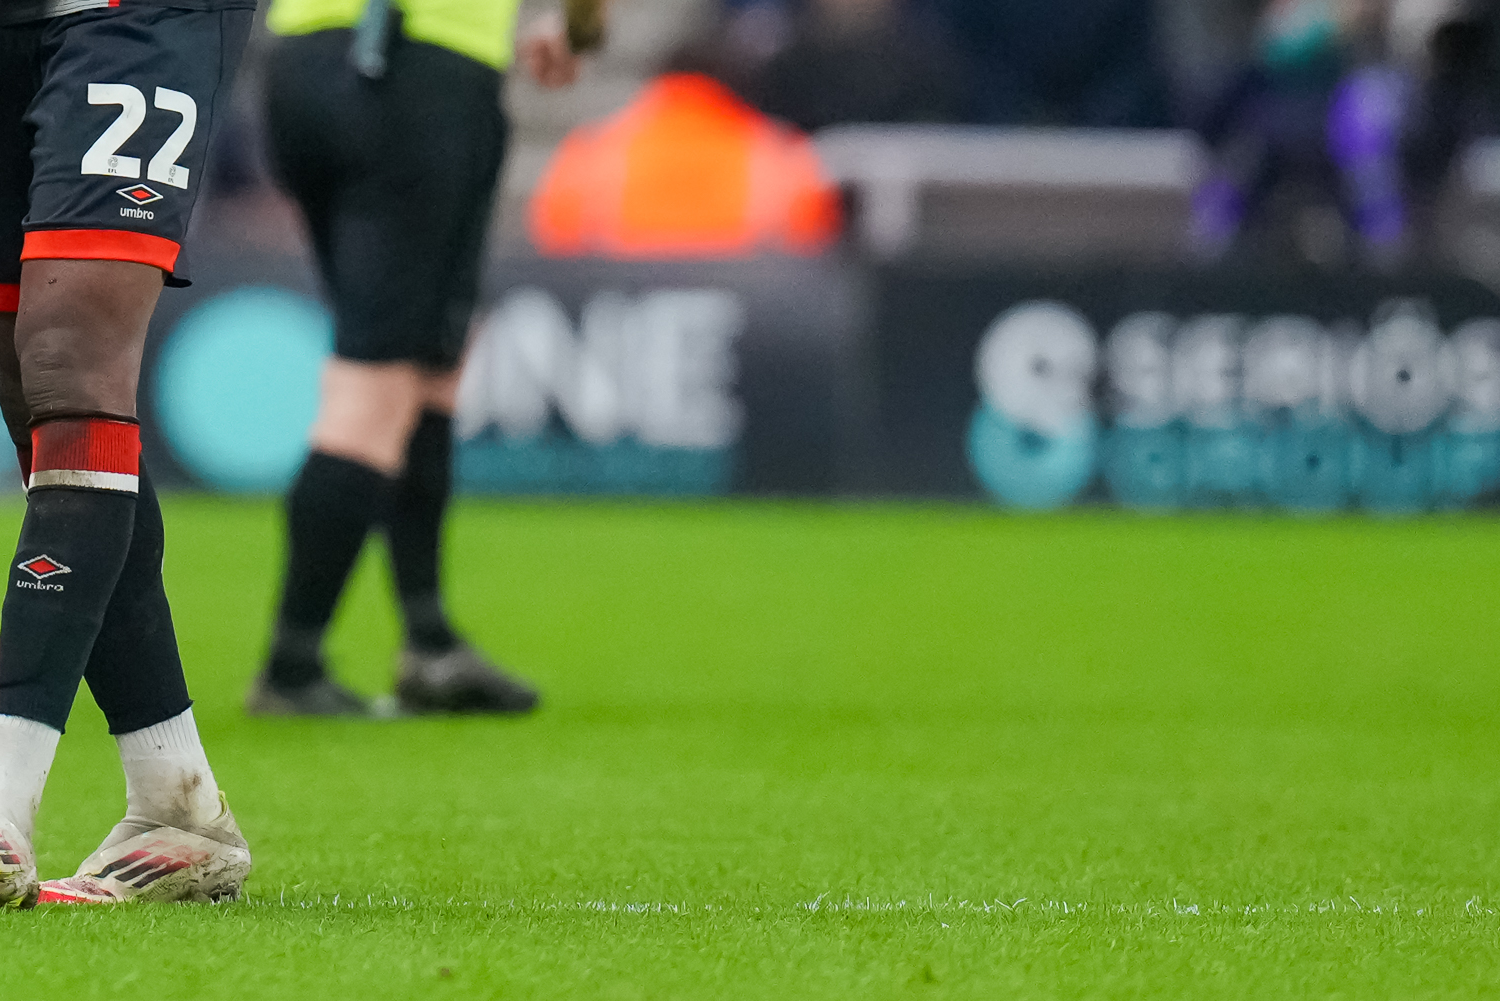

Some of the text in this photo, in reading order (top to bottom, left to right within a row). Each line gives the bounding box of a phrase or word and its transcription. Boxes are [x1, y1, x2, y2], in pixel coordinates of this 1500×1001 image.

[81, 83, 197, 189] 22
[119, 207, 154, 220] umbro
[16, 580, 64, 592] umbro
